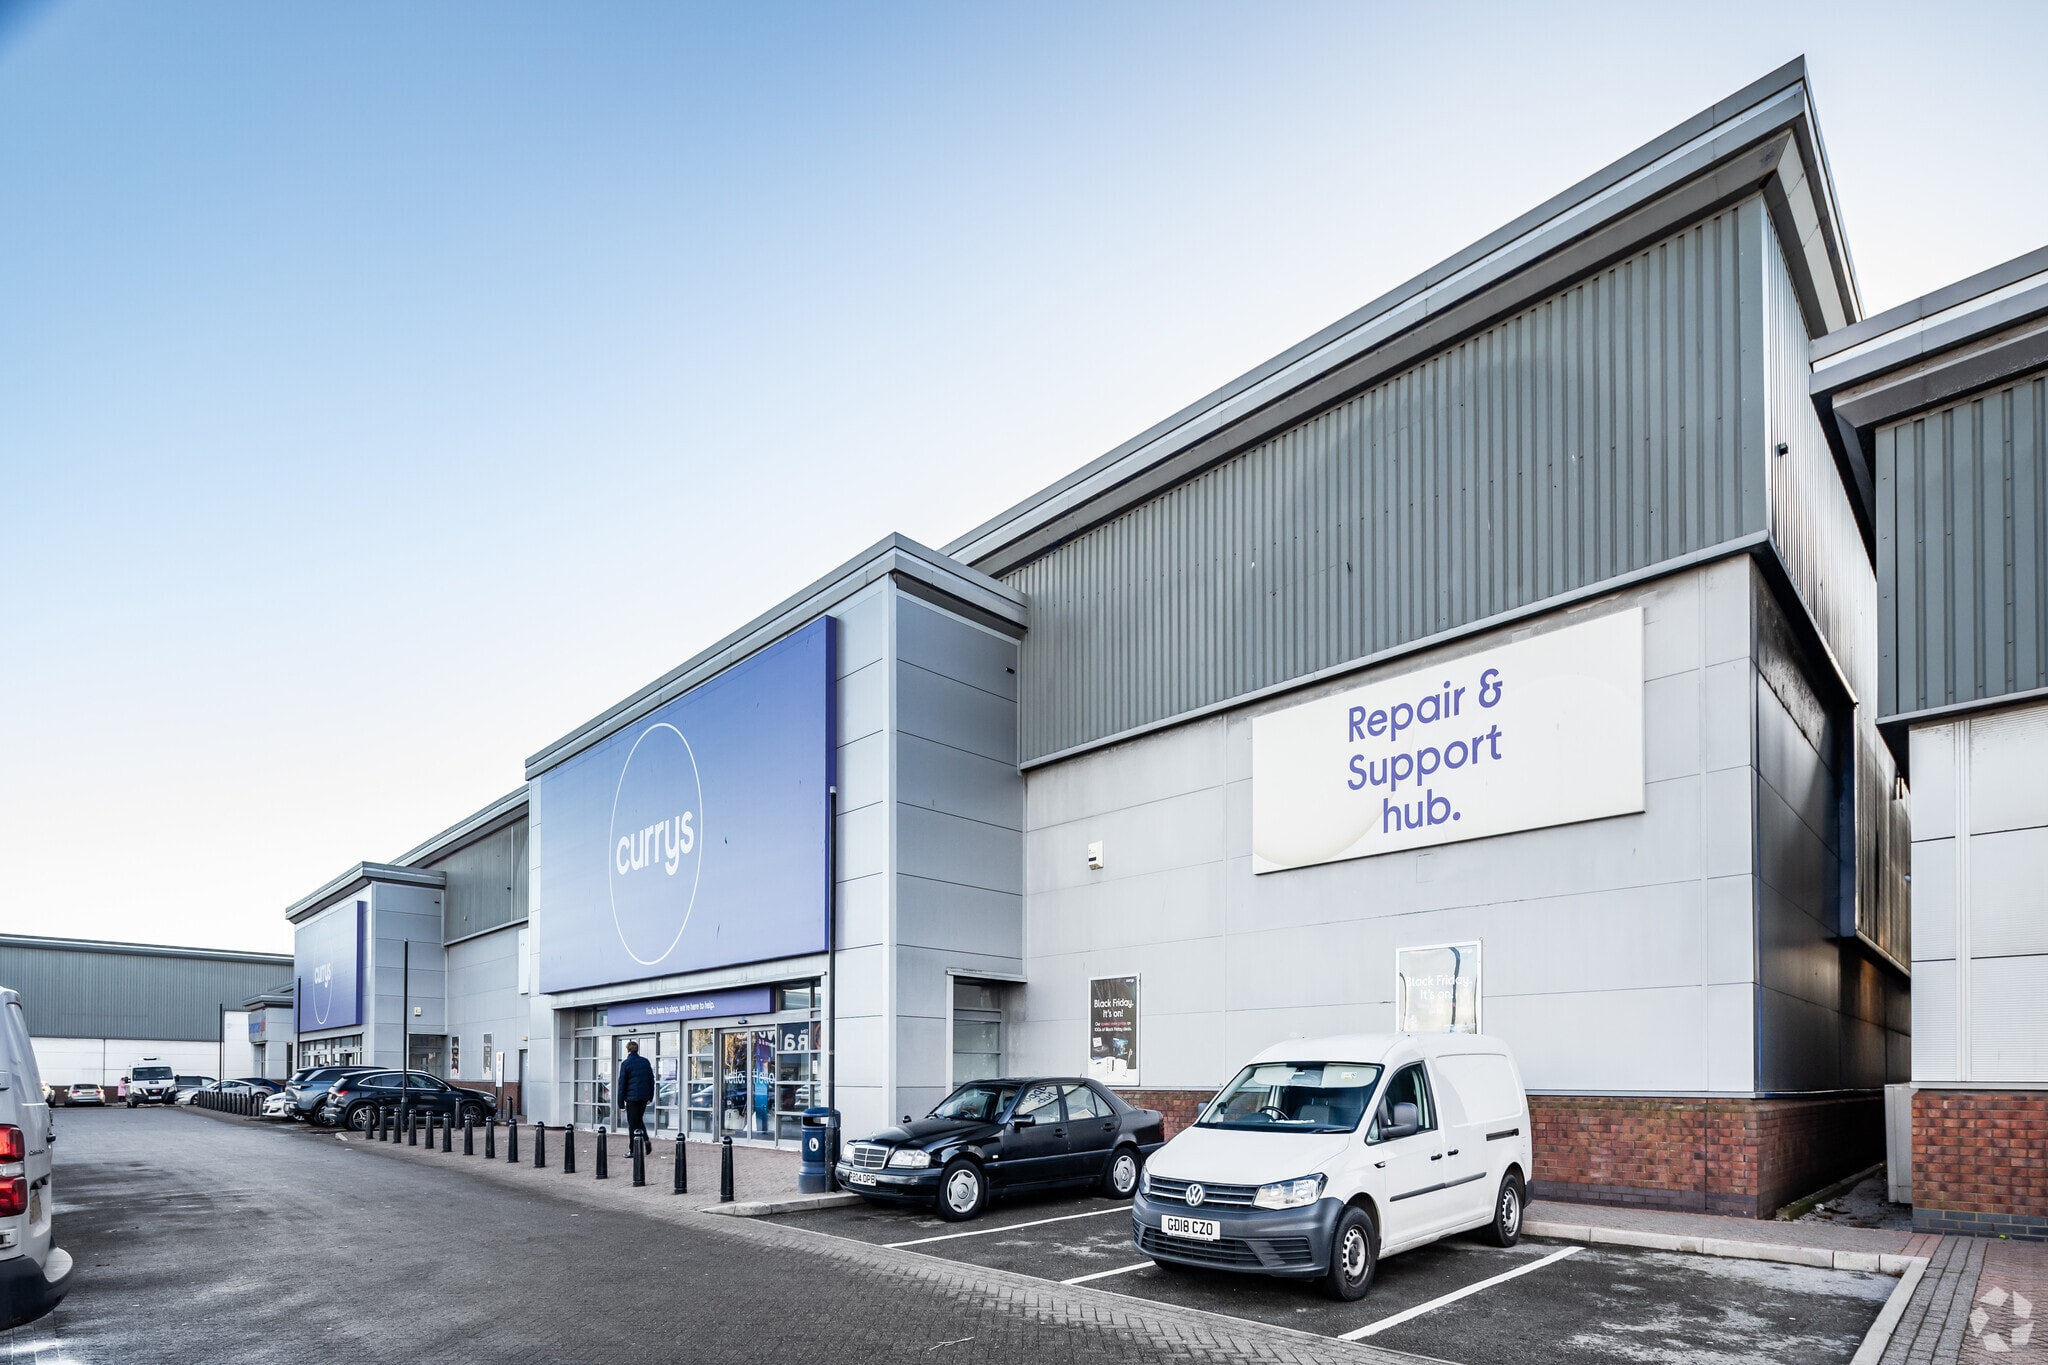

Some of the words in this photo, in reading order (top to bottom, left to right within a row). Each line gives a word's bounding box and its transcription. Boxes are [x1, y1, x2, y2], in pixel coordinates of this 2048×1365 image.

[1349, 680, 1466, 742] Repair
[1478, 668, 1503, 709] &
[1347, 725, 1502, 791] Support
[1383, 789, 1461, 833] hub.
[616, 811, 694, 875] currys
[315, 962, 332, 988] currys
[1406, 976, 1433, 987] Black
[1436, 975, 1472, 988] Friday.
[1094, 999, 1111, 1008] Black
[1112, 998, 1134, 1008] Friday.
[1420, 989, 1435, 1000] It's
[1437, 988, 1454, 1000] on!
[1103, 1010, 1112, 1018] It's
[1113, 1009, 1124, 1017] on!
[1168, 1218, 1189, 1232] GD18
[1192, 1221, 1212, 1236] CZO
